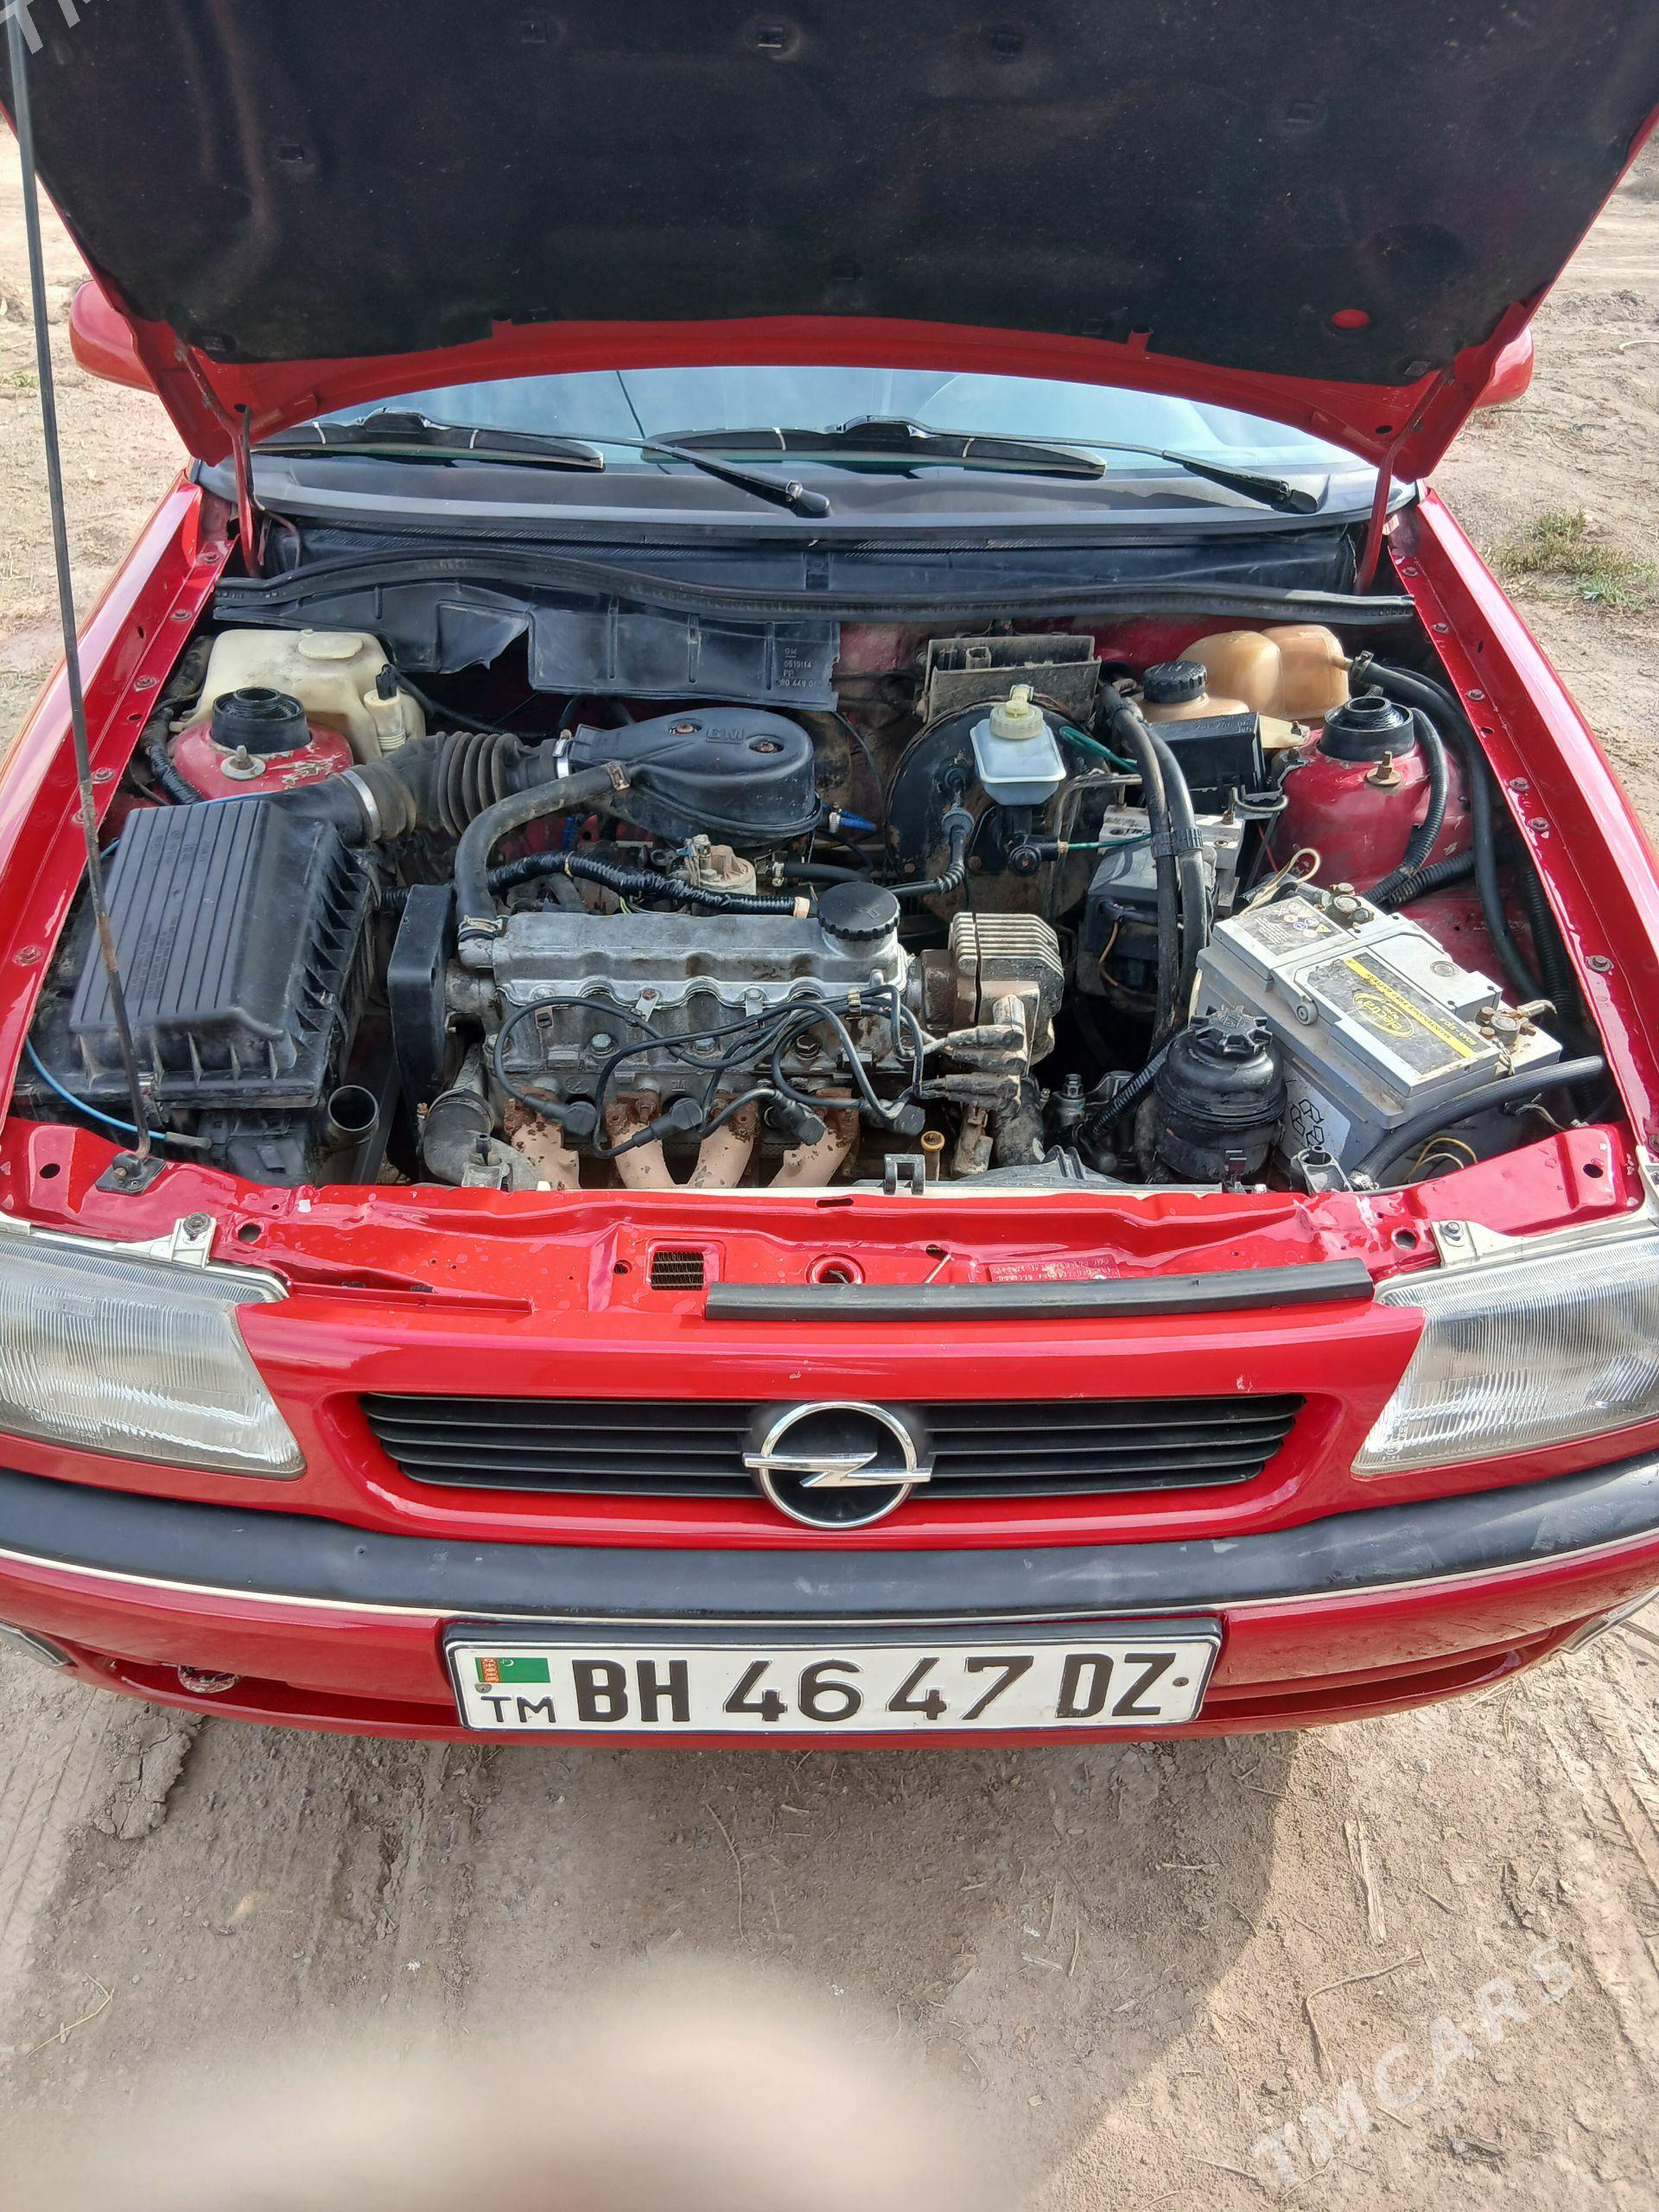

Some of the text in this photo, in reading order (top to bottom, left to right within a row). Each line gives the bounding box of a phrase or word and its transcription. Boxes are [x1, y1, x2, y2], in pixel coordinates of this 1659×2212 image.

[1365, 973, 1393, 993] BATTERY
[1362, 1000, 1403, 1031] electra
[1407, 1005, 1452, 1039] MAINTENANCE
[571, 1659, 690, 1722] BH
[1054, 1652, 1177, 1719] DZ
[480, 1695, 556, 1723] TM
